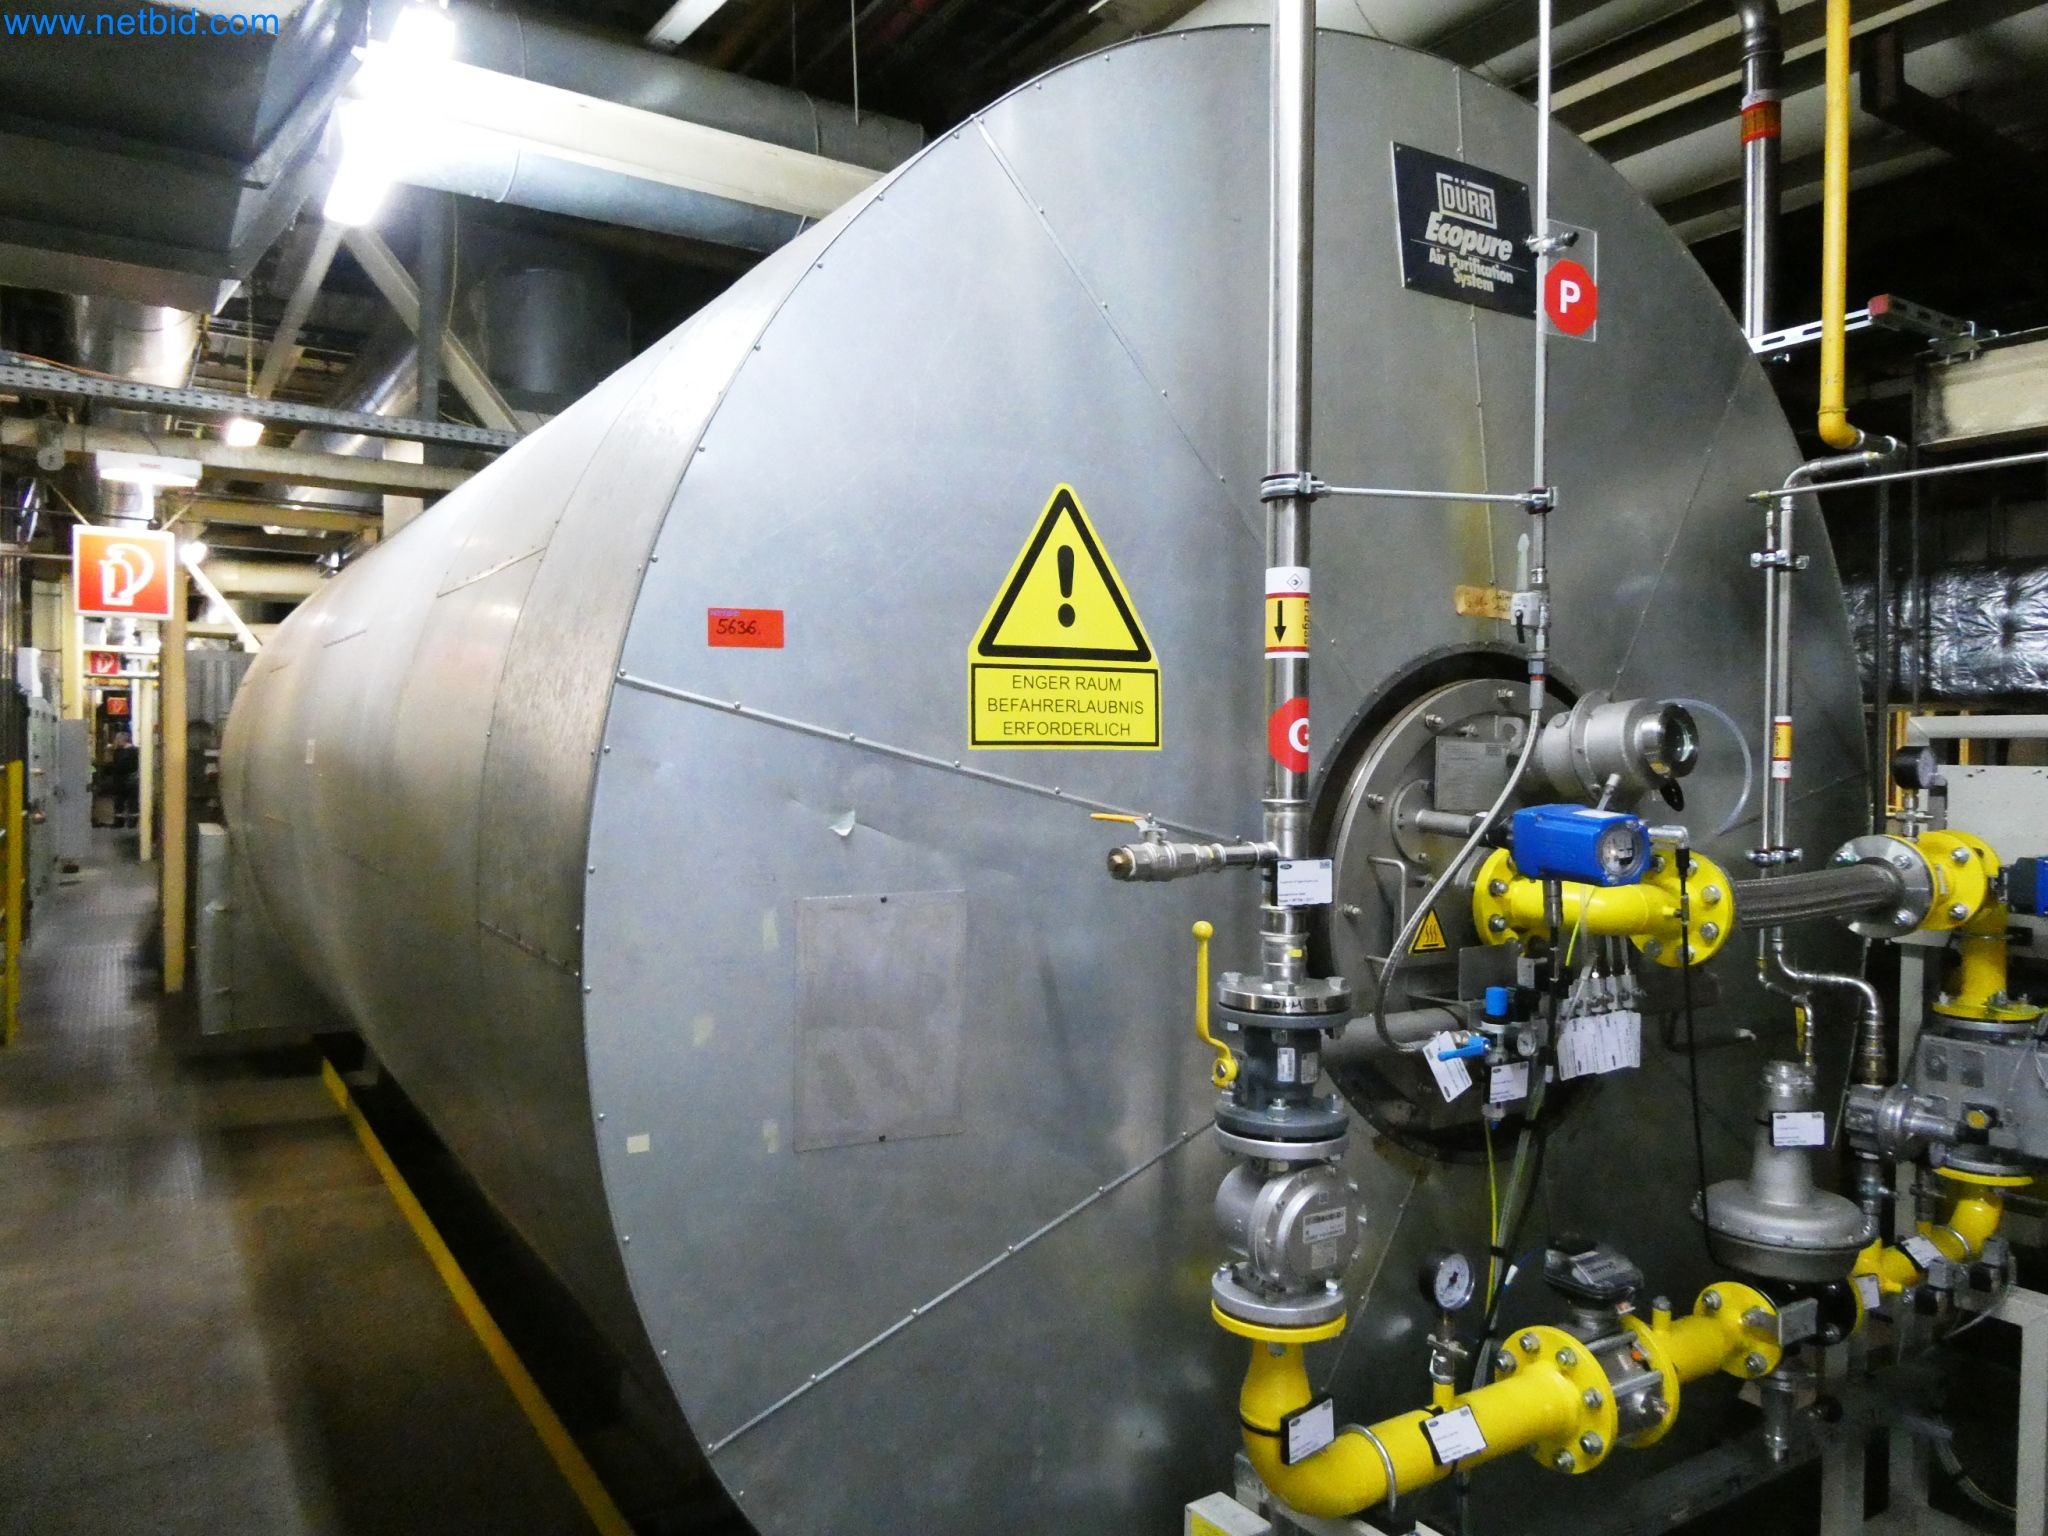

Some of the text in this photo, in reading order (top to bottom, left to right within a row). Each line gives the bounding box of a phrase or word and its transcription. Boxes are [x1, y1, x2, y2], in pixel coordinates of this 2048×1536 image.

[1441, 179, 1493, 221] DÜRR
[1425, 211, 1513, 262] Ecopure
[1429, 247, 1514, 285] Air Purification
[1453, 267, 1494, 293] System
[1560, 279, 1581, 314] P
[716, 618, 757, 635] 5636
[1012, 675, 1121, 691] ENGER RAUM
[988, 697, 1144, 714] BEFAHRERLAUBNIS
[1003, 721, 1130, 736] ERFORDERLICH
